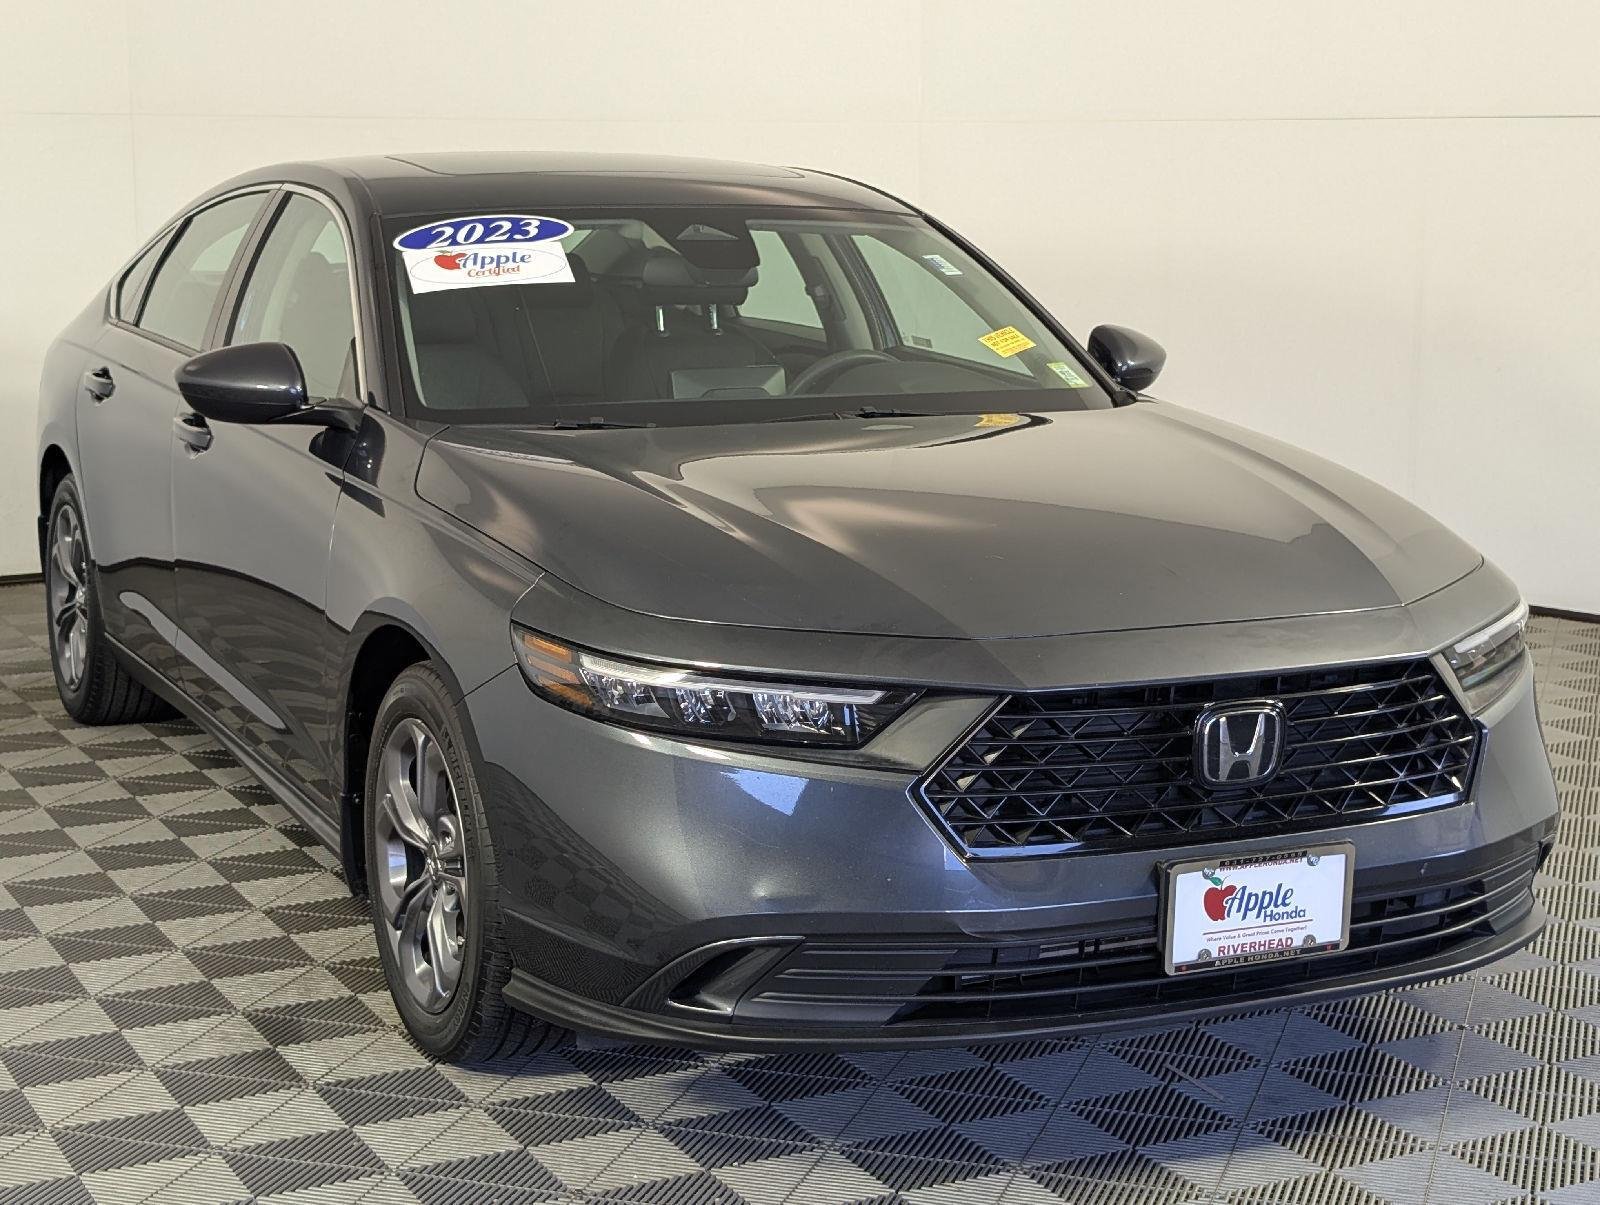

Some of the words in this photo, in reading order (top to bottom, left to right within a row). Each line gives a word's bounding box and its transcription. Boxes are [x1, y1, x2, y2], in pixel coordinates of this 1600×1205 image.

[426, 219, 540, 249] 2023
[457, 251, 532, 270] Apple
[467, 265, 521, 278] Certified
[1225, 883, 1294, 921] Apple
[1263, 906, 1306, 922] Honda
[1217, 937, 1294, 956] RIVERHEAD
[1215, 957, 1245, 967] APPLE
